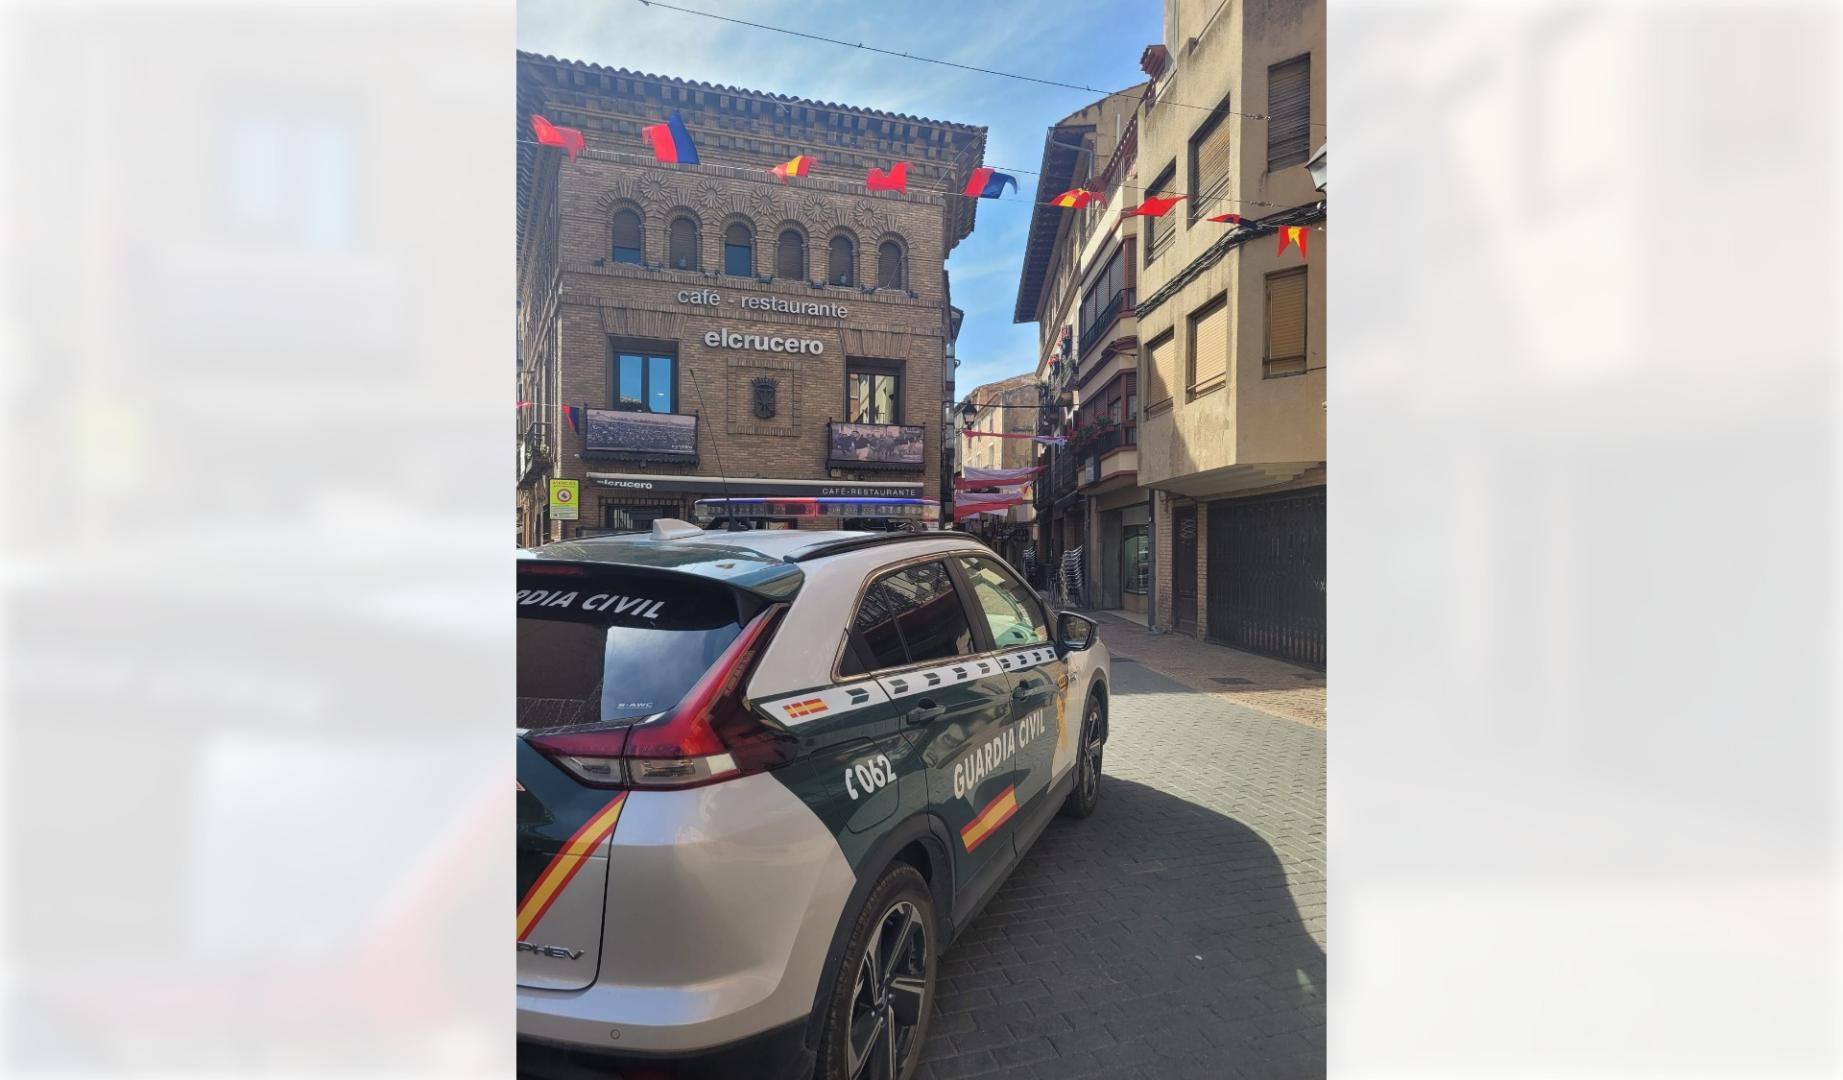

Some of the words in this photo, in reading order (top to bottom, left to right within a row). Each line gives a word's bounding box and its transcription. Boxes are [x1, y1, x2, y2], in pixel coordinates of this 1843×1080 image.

[677, 289, 721, 306] café
[741, 295, 848, 319] restaurante
[704, 327, 824, 355] elcrucero
[581, 593, 665, 619] CIVIL
[953, 727, 1016, 800] GUARDIA
[1018, 709, 1046, 749] CIVIL
[856, 754, 897, 794] 062
